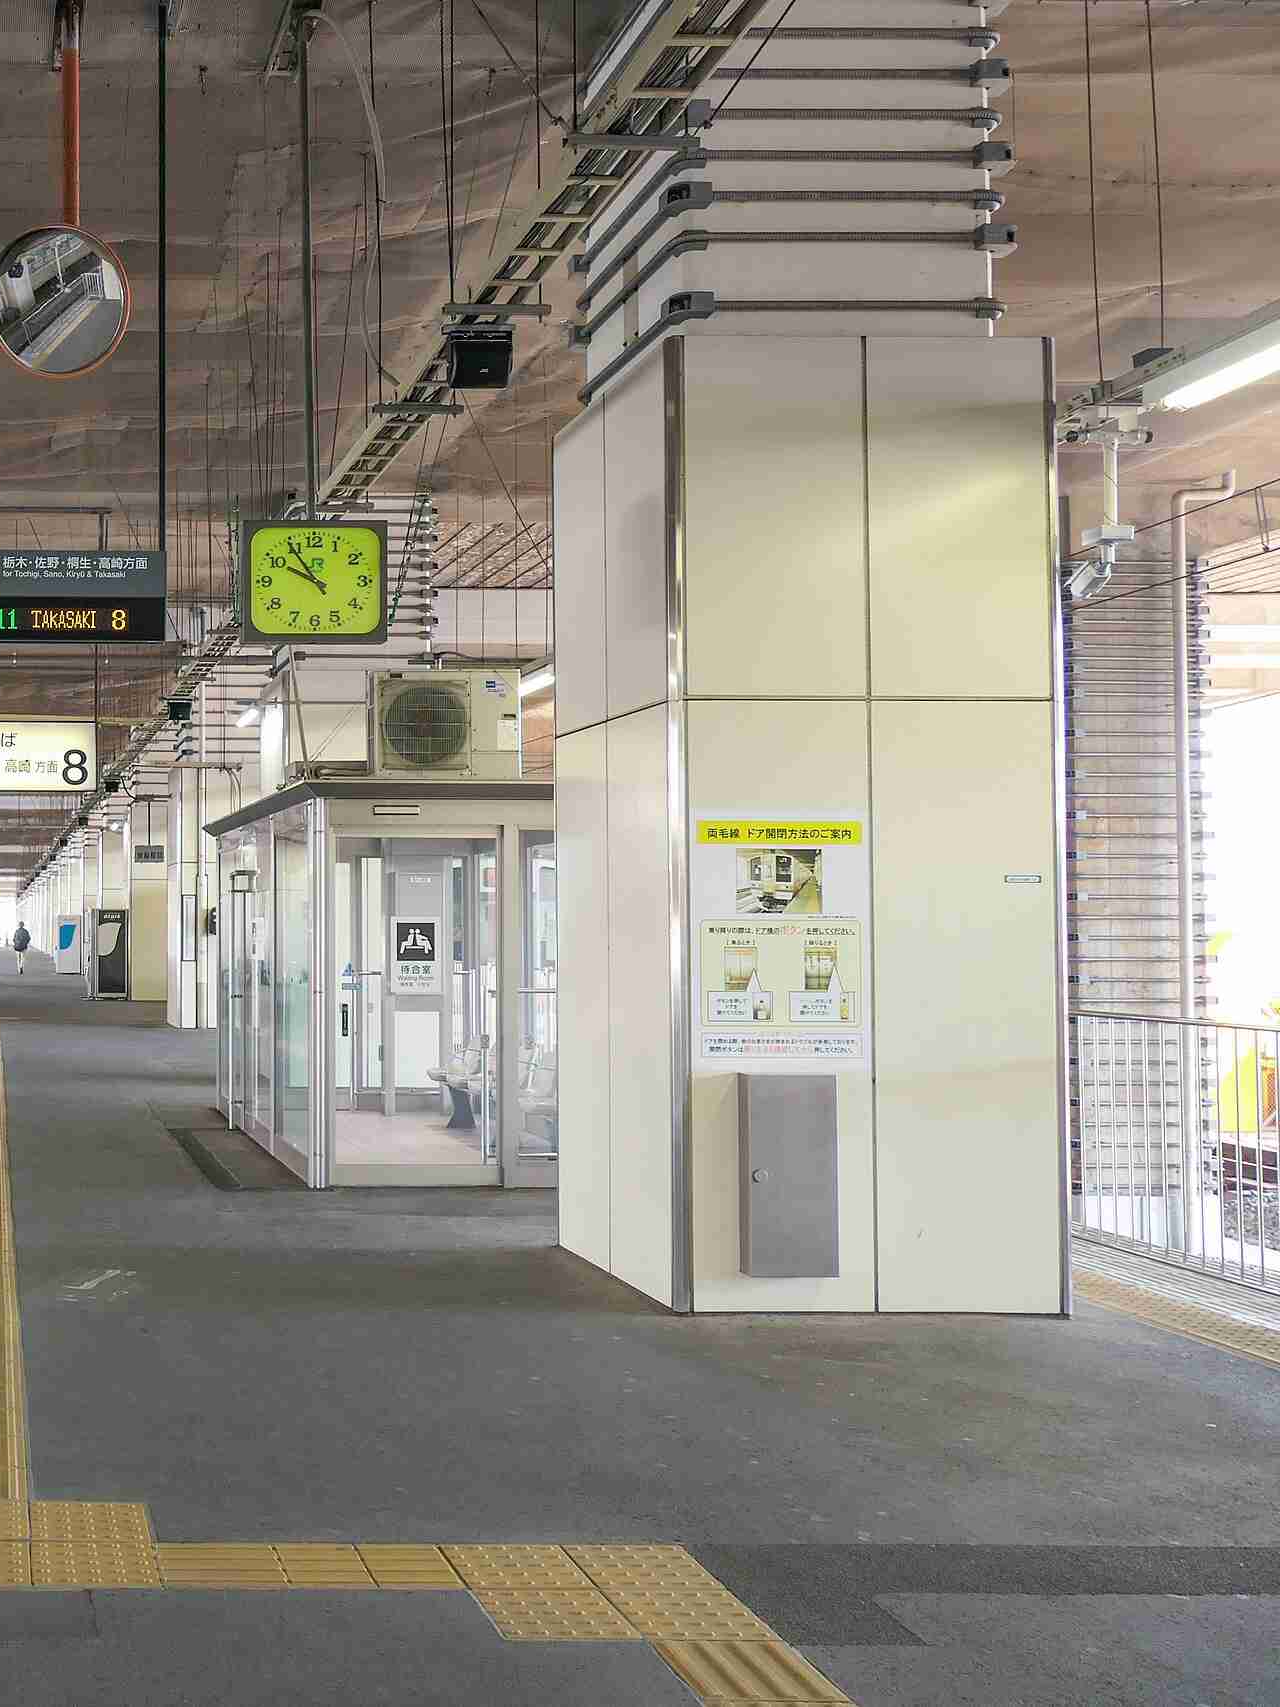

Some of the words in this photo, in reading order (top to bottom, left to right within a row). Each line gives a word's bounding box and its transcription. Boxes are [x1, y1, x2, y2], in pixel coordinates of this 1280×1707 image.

[288, 542, 302, 554] 11
[305, 536, 323, 548] 12
[332, 540, 338, 552] 1
[270, 556, 286, 568] 10
[348, 553, 360, 565] 2
[43, 570, 64, 578] Sano,
[261, 575, 272, 587] 9
[357, 575, 368, 587] 3
[270, 598, 281, 609] 8
[347, 598, 360, 608] 4
[31, 610, 96, 629] TAKASAKI
[111, 609, 126, 630] 8
[289, 611, 300, 623] 7
[310, 615, 320, 626] 6
[329, 610, 340, 622] 5
[62, 750, 88, 785] 8
[707, 828, 739, 839] 両毛線
[747, 828, 851, 840] ドア開閉方法のご案内
